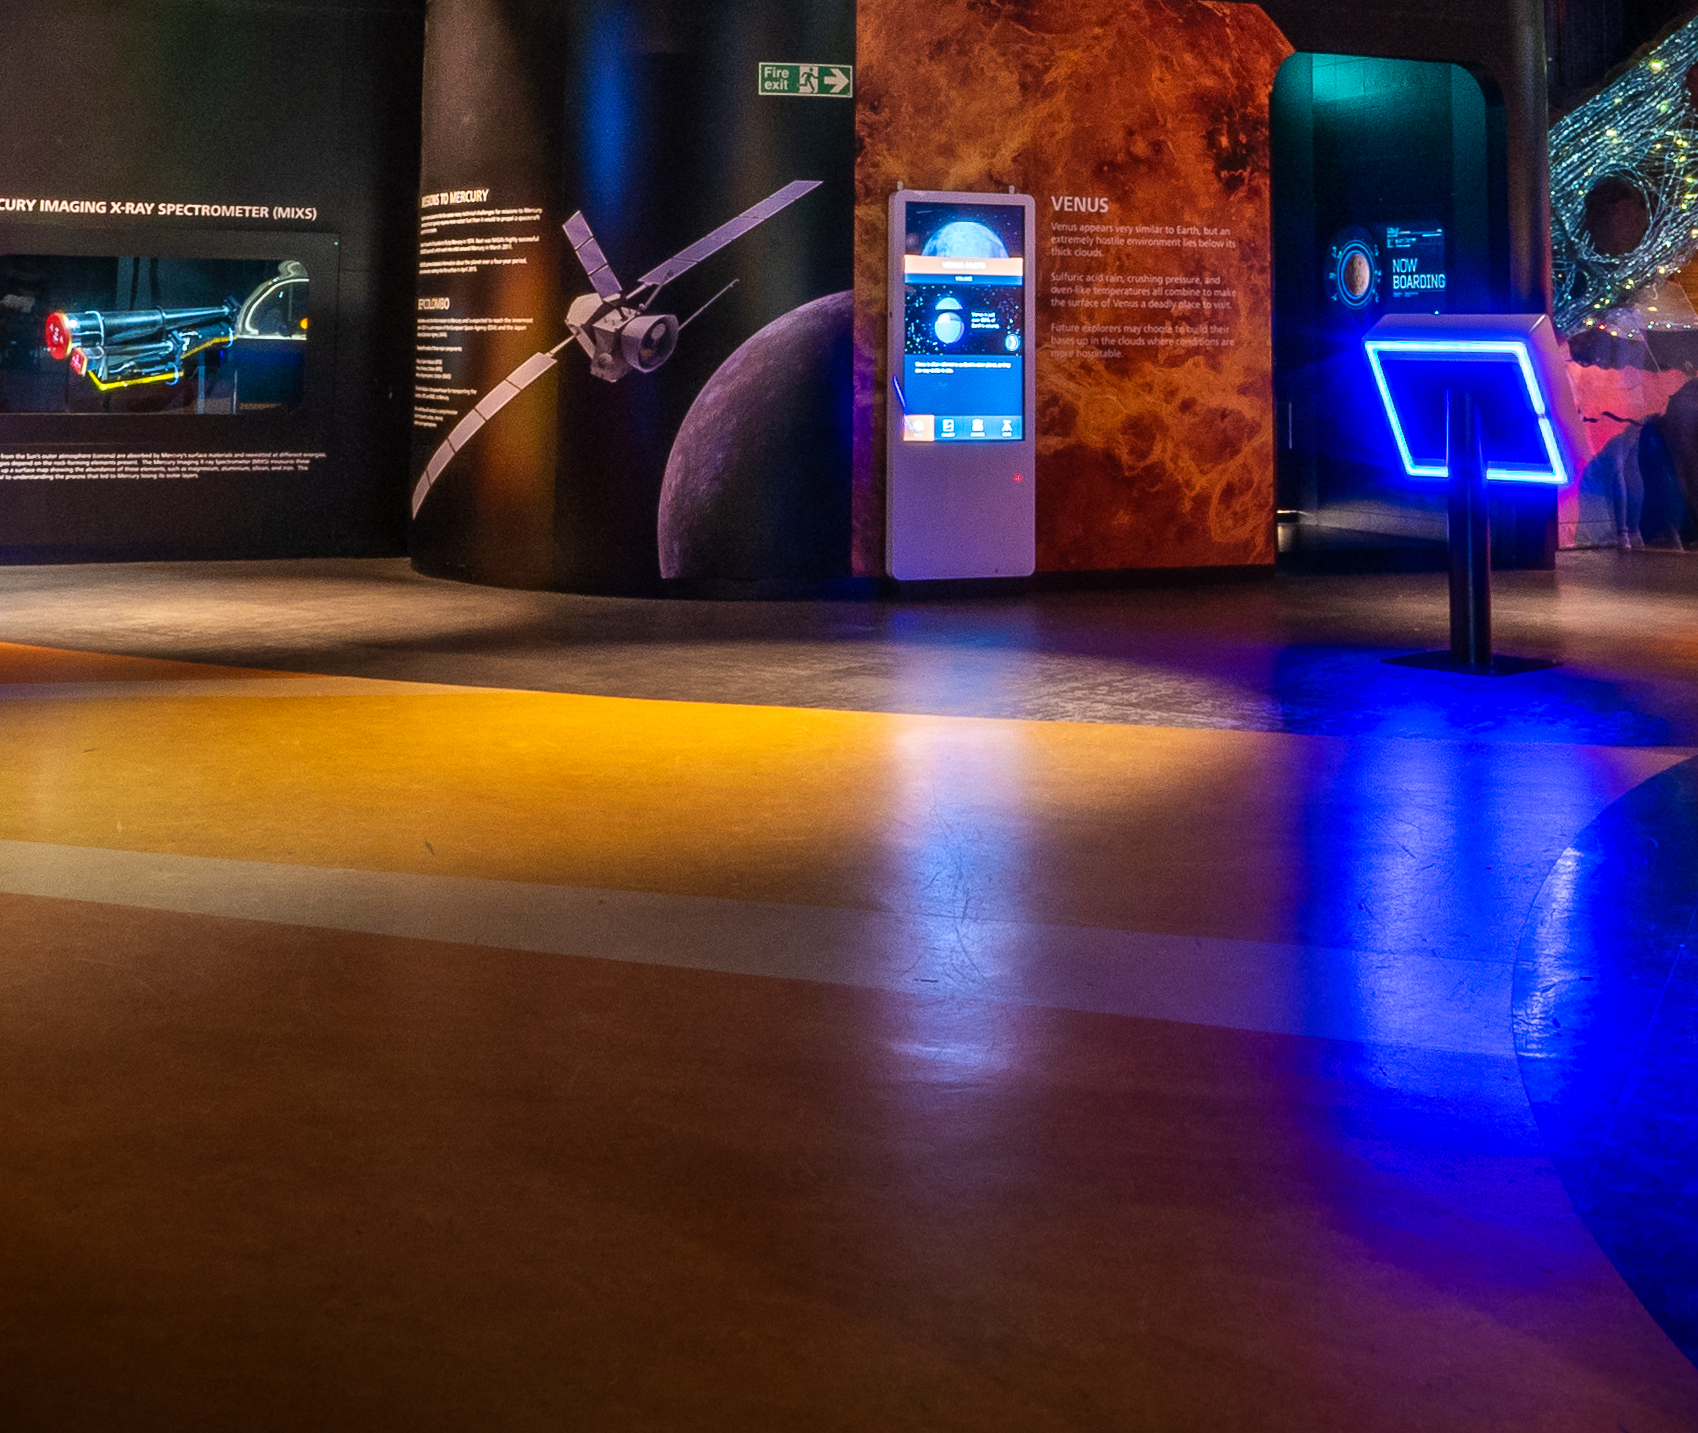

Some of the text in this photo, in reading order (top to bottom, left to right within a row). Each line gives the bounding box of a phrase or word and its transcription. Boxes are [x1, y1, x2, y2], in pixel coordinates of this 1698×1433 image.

[764, 66, 790, 79] Fire
[764, 79, 789, 90] exit
[439, 192, 449, 205] TO
[449, 188, 490, 204] MERCURY
[1051, 195, 1109, 213] VENUS
[39, 199, 107, 214] IMAGING
[109, 201, 155, 216] X-RAY
[157, 202, 270, 219] SPECTROMETER
[272, 206, 318, 222] (MIXS)
[1051, 222, 1230, 236] Venus appears very similar to Earth, but an
[1051, 236, 1236, 248] extremely hostile environment lies below its
[1392, 258, 1418, 273] NOW
[1392, 274, 1446, 289] BOARDING
